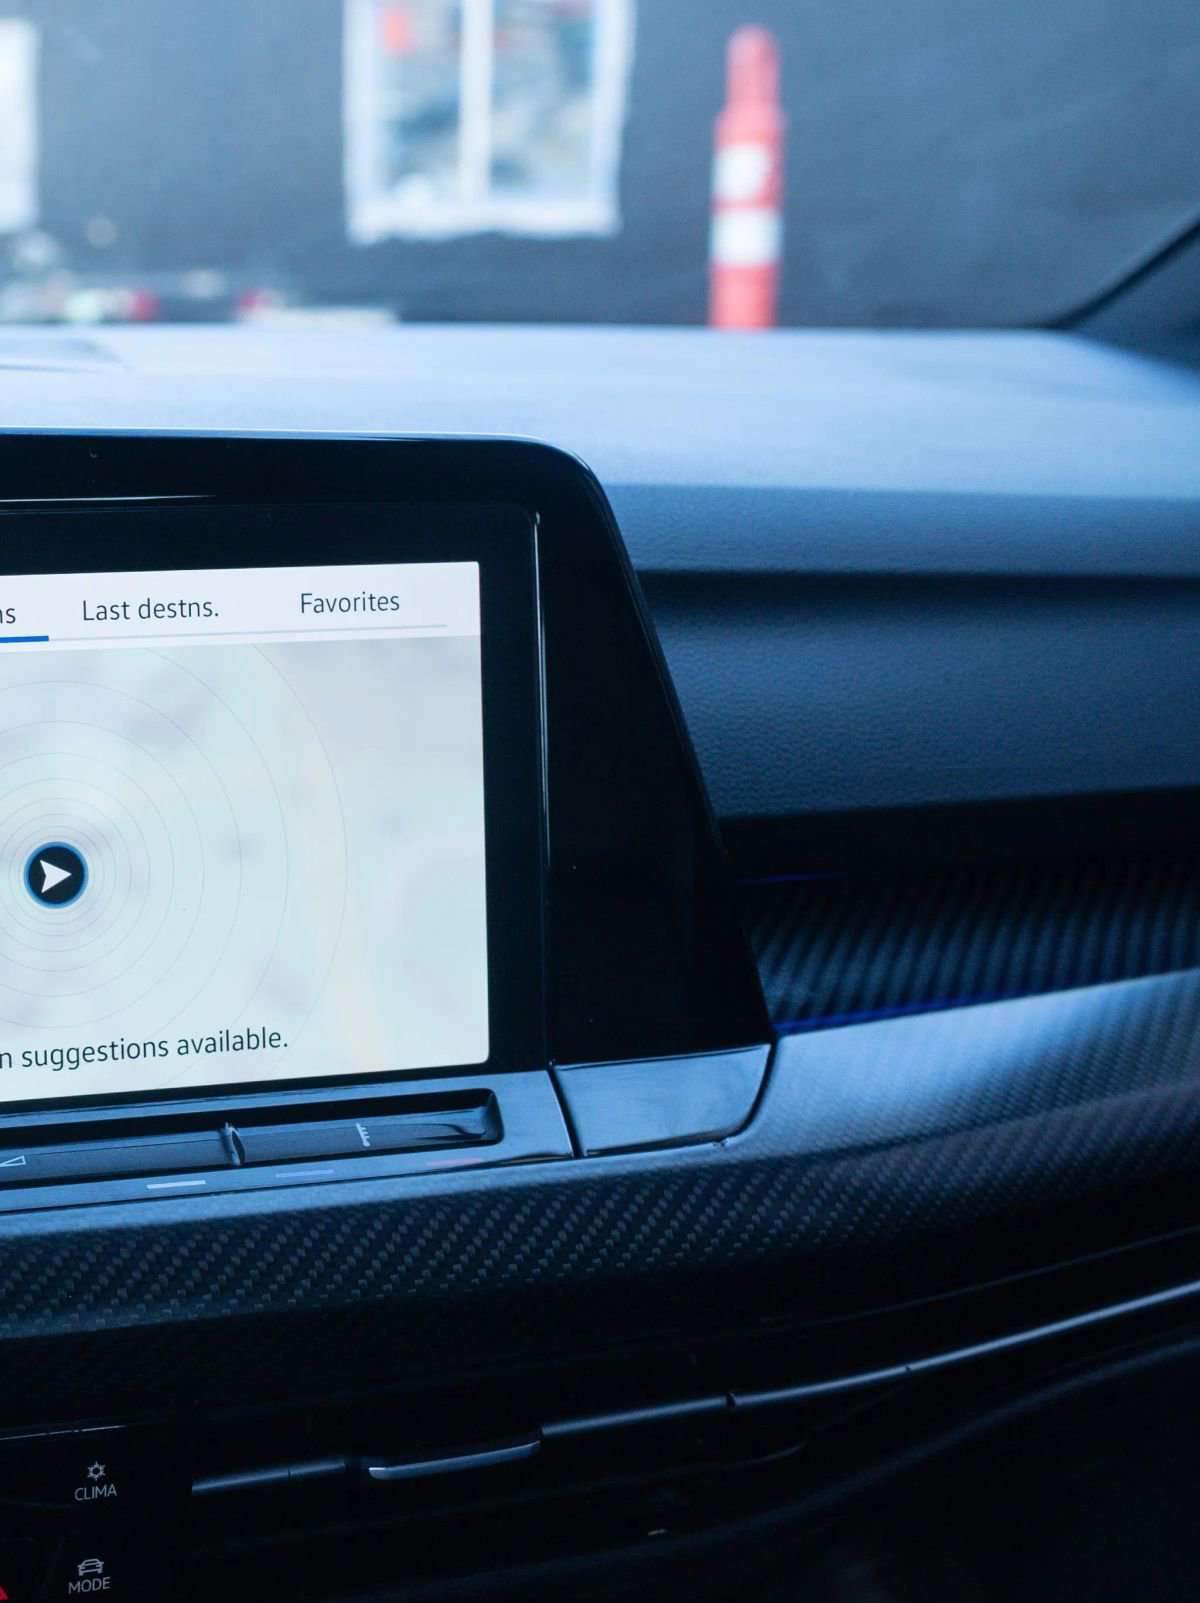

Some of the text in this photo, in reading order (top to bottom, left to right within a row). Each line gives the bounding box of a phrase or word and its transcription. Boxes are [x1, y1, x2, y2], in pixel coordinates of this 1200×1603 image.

[83, 598, 218, 620] Last destns.
[301, 592, 399, 613] Favorites
[22, 1038, 168, 1071] suggestions
[178, 1027, 287, 1055] available.
[75, 1484, 117, 1500] CLIMA
[69, 1577, 110, 1593] MODE
